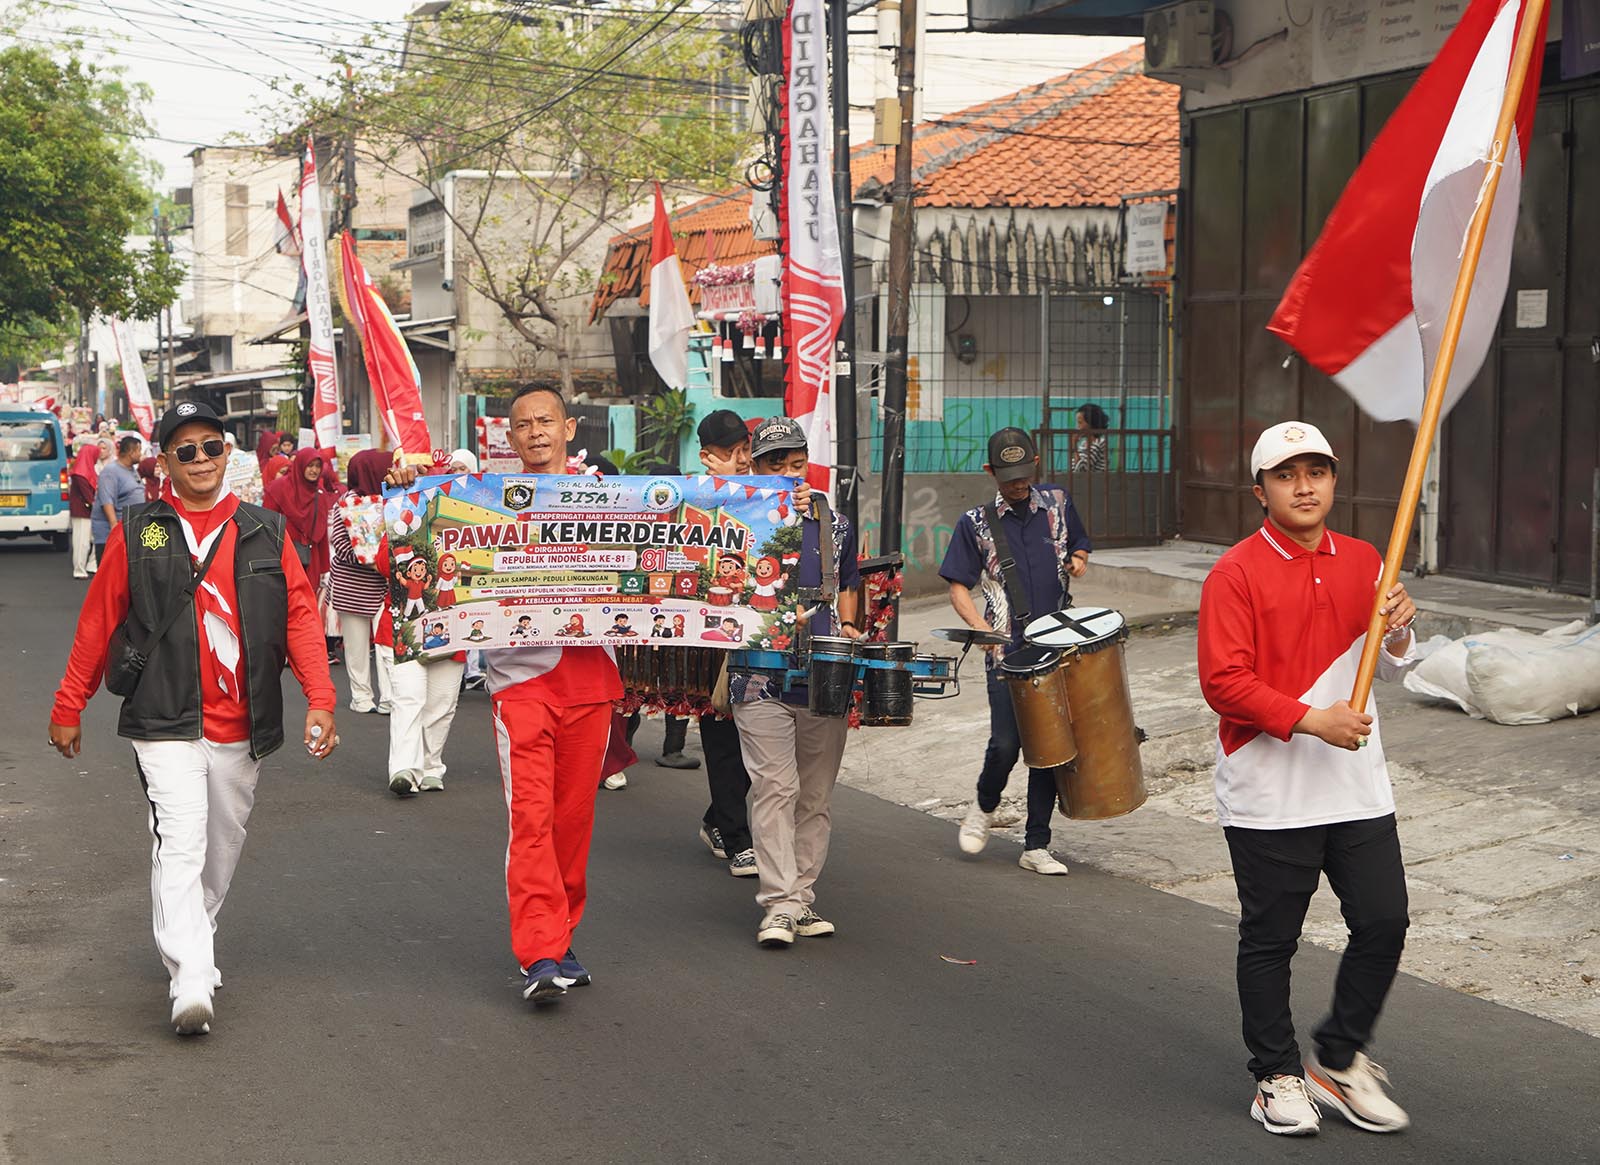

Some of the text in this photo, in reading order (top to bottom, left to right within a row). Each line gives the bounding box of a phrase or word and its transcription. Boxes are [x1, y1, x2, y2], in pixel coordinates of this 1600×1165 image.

[759, 424, 791, 441] BROOKLYN
[585, 481, 609, 489] FALAH
[560, 492, 610, 505] BISA
[531, 513, 657, 521] MEMPERINGATI HARI KEMERDEKAAN
[444, 522, 745, 551] PAWAI KEMERDEKAAN
[502, 556, 545, 564] REPUBLIK
[548, 554, 596, 563] INDONESIA
[600, 554, 625, 562] KE-81
[641, 549, 665, 571] 81
